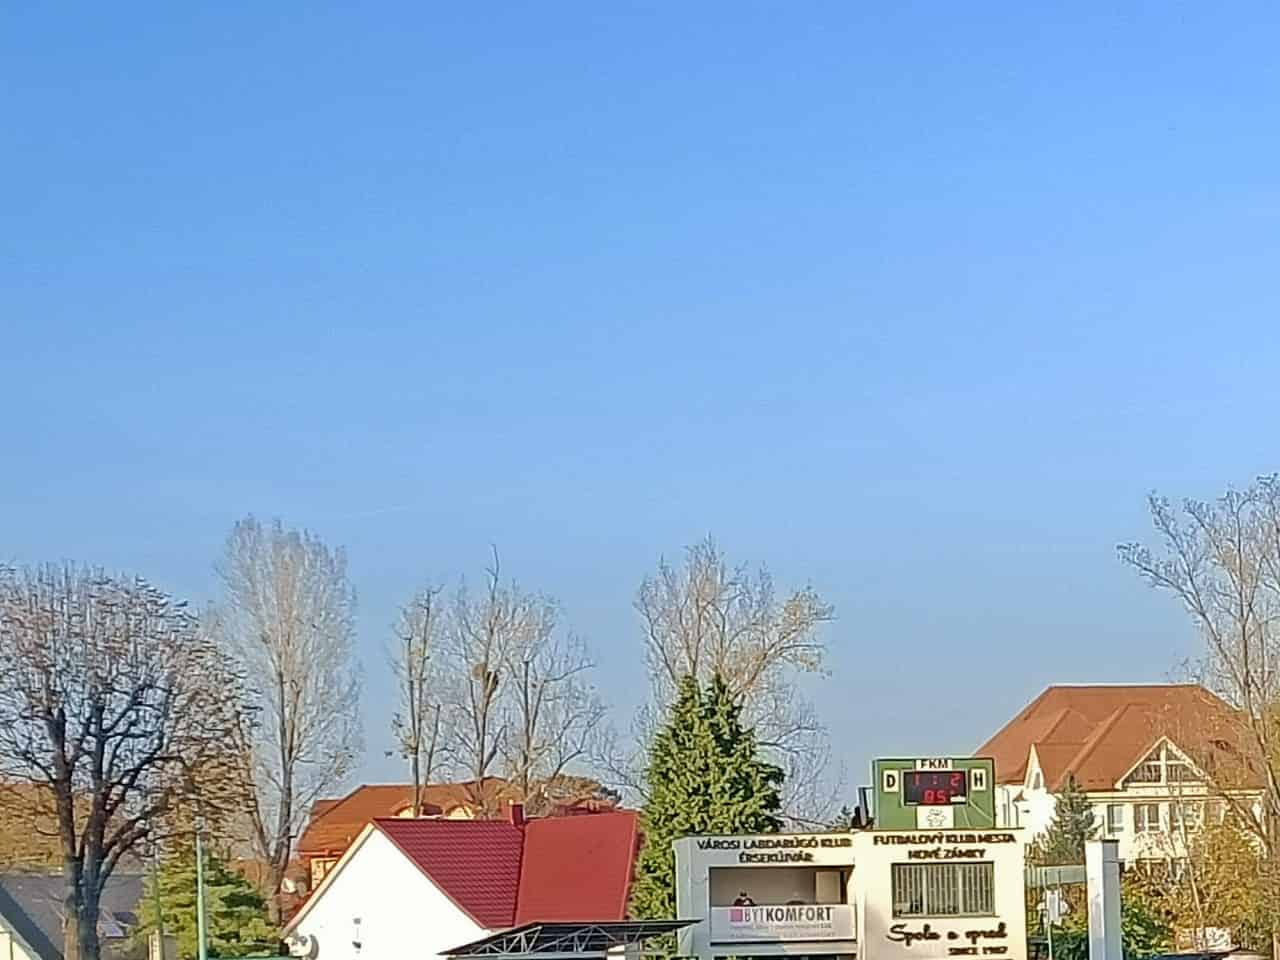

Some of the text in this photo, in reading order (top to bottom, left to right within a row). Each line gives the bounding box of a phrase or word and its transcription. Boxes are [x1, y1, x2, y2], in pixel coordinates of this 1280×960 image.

[919, 759, 949, 769] FKM
[885, 774, 896, 788] D
[973, 772, 984, 787] H
